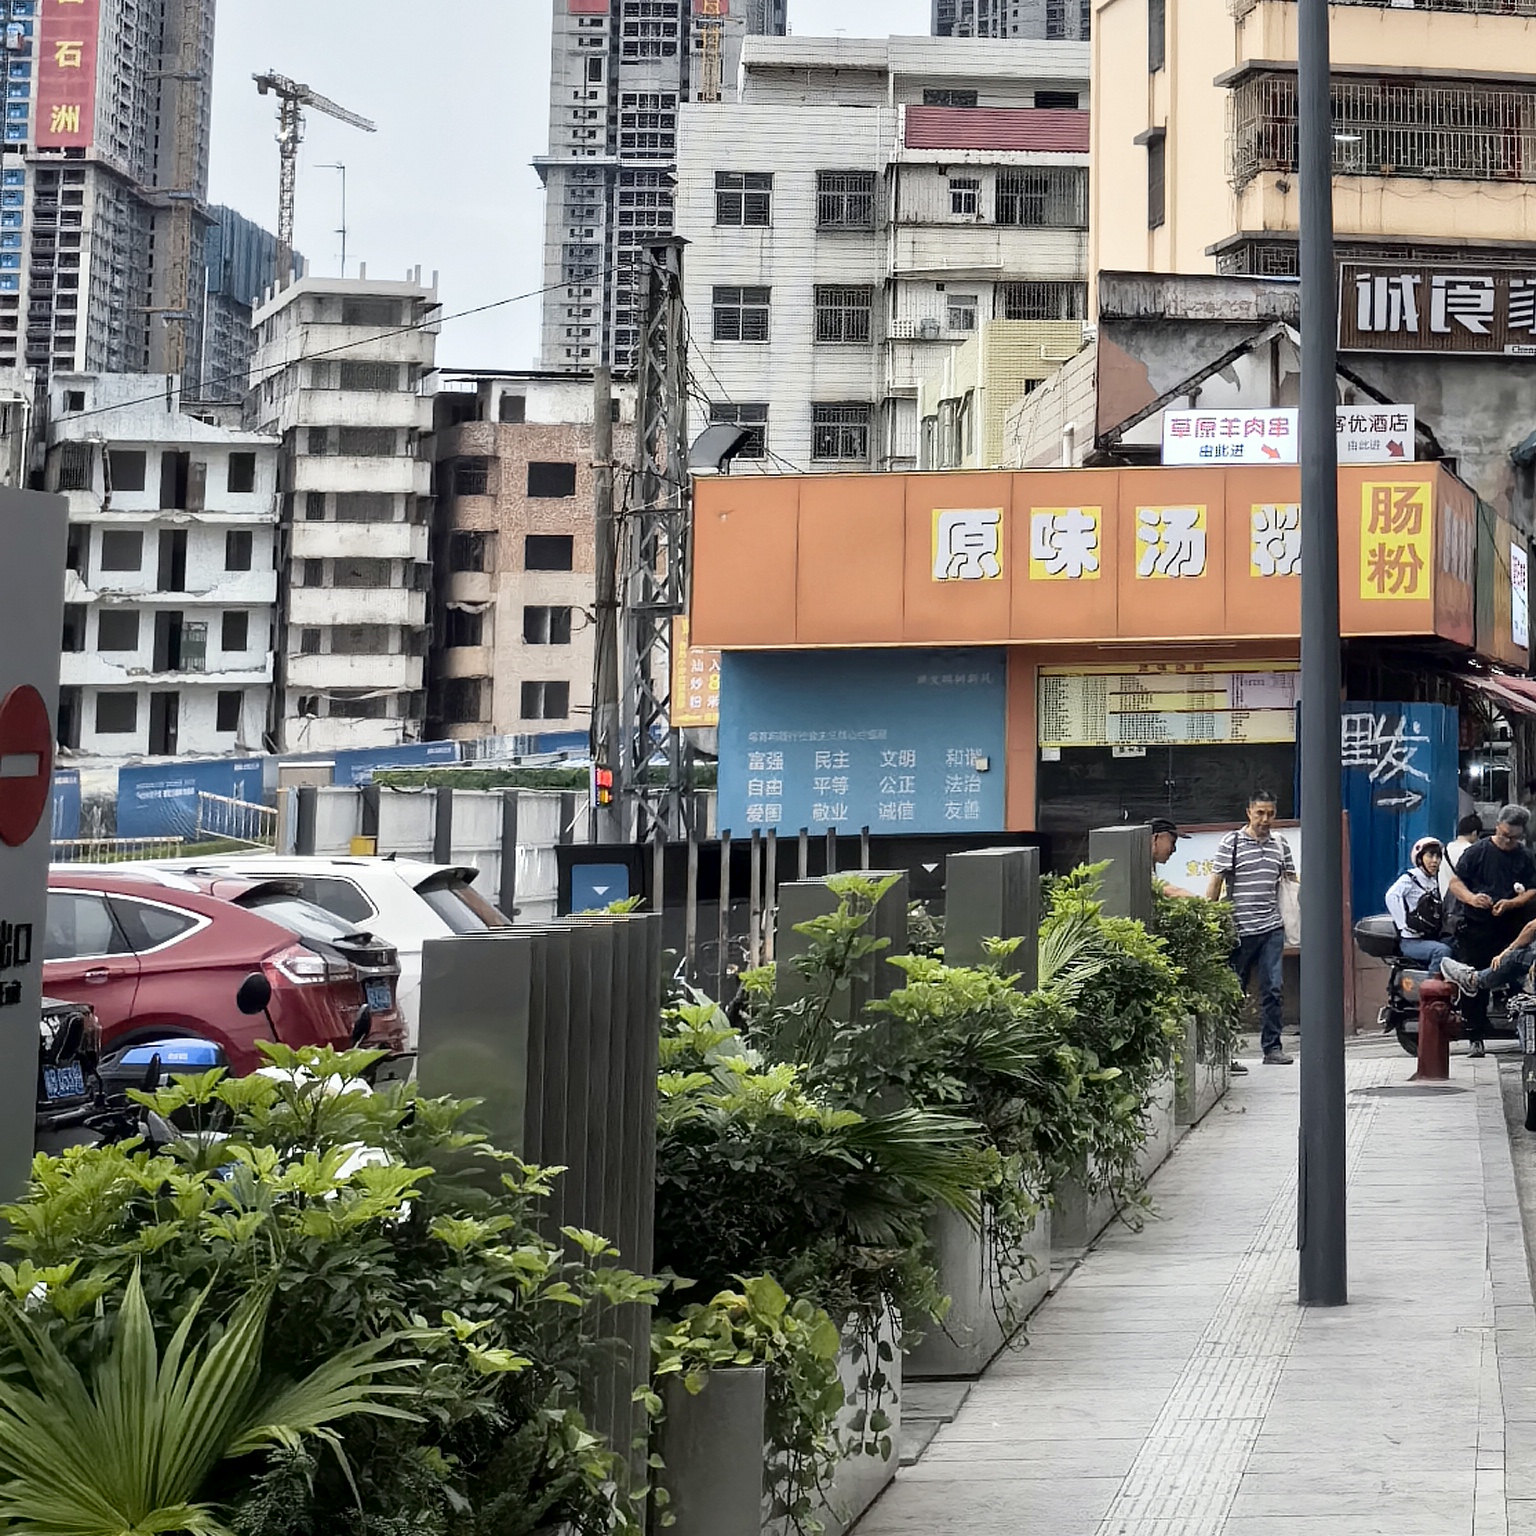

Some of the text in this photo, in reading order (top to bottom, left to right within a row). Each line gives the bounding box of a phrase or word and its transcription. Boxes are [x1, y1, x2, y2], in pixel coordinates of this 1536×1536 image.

[1170, 416, 1290, 439] 草原羊肉串
[1199, 444, 1245, 459] 由此进
[1347, 439, 1381, 452] 由此进
[1367, 485, 1423, 595] 肠粉
[747, 748, 983, 771] 富强 民主 文明 和谐
[747, 774, 982, 797] 自由 平等 公正 法治
[746, 799, 980, 823] 爱国 敬业 诚信 友善
